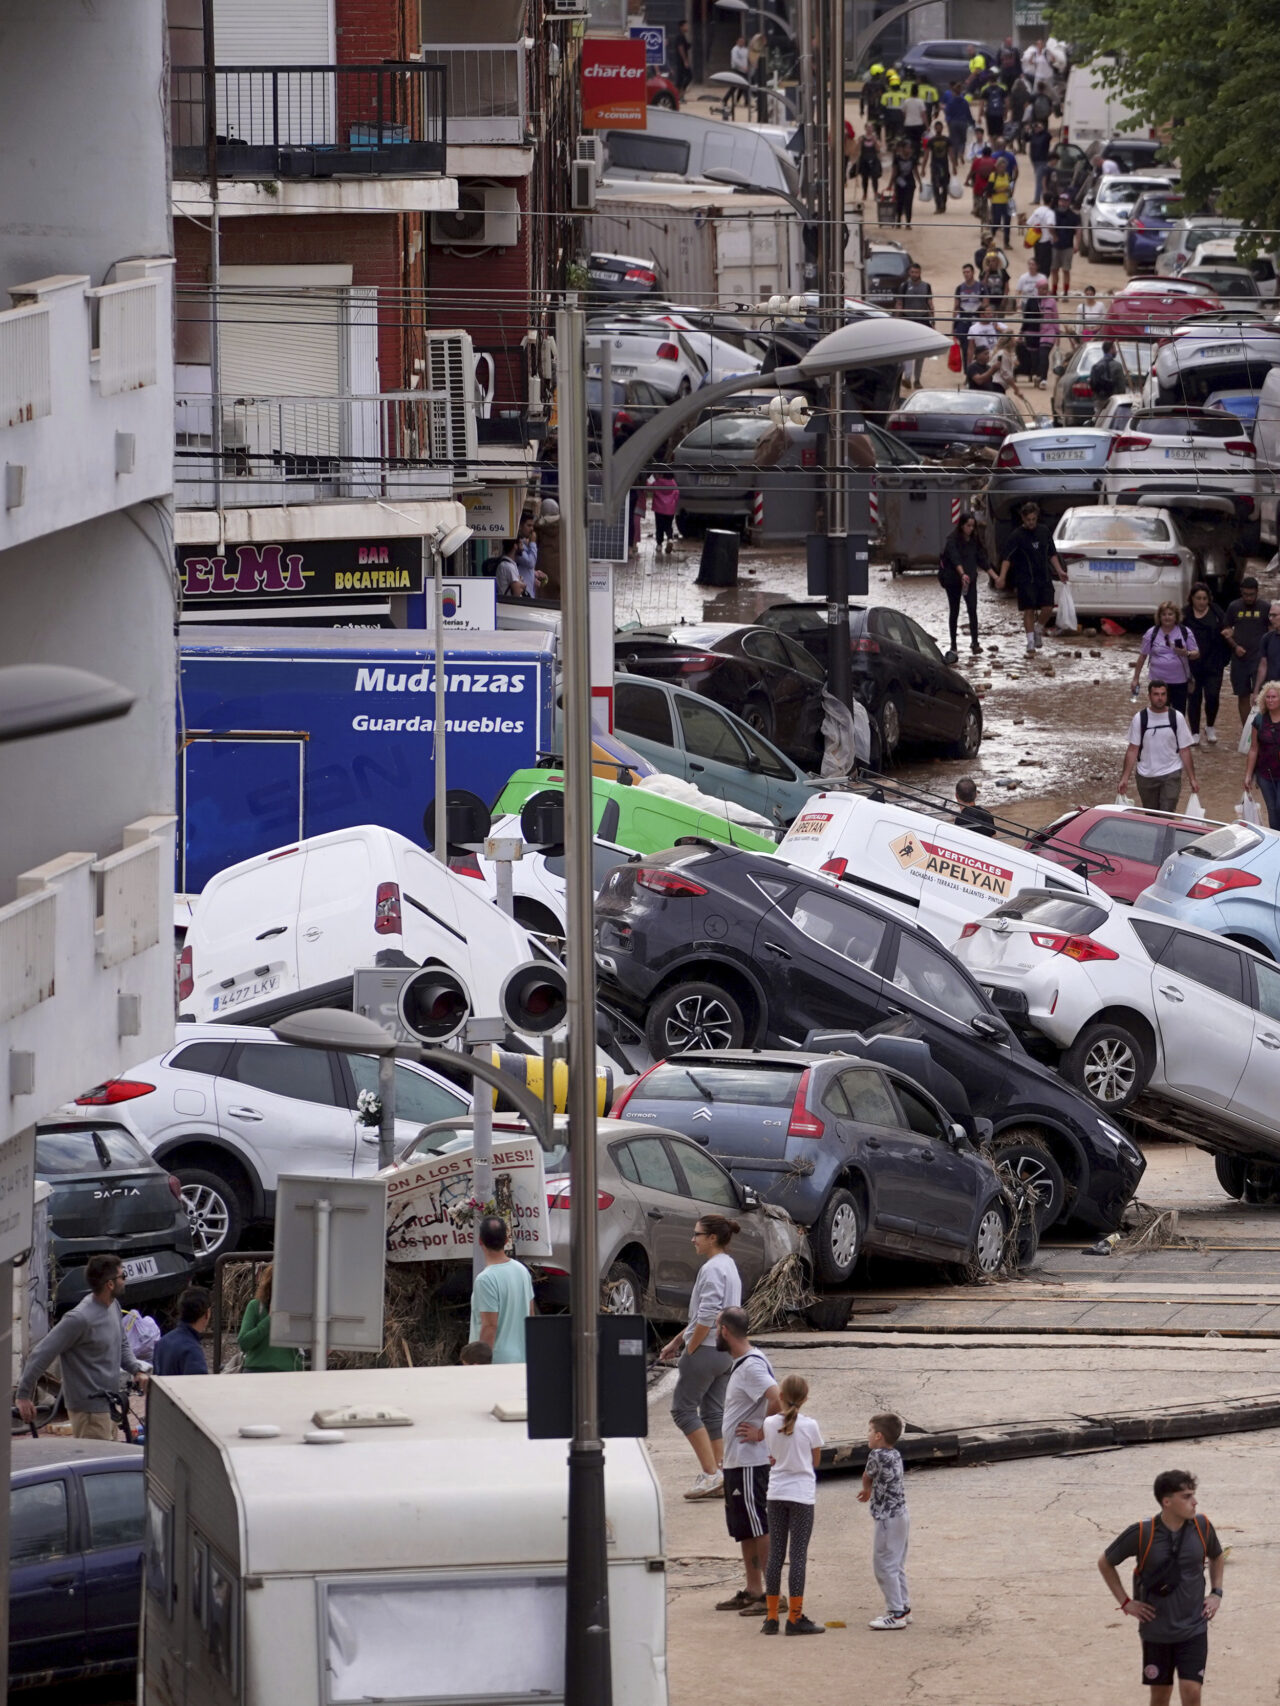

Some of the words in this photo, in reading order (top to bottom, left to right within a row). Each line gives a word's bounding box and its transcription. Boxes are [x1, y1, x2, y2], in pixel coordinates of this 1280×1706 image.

[583, 64, 645, 78] charter
[604, 112, 642, 120] consum
[489, 524, 505, 532] 694
[358, 546, 390, 565] BAR
[334, 567, 411, 590] BOCATERÍA
[465, 620, 470, 628] y
[354, 668, 526, 693] Mudanzas
[937, 847, 1002, 877] VERTICALES
[926, 857, 1006, 894] APELYAN
[221, 987, 250, 1005] 4477
[253, 978, 277, 994] LKV
[762, 1119, 782, 1127] C4
[415, 1173, 426, 1184] A
[429, 1161, 461, 1179] LOS
[93, 1188, 140, 1199] DACIA
[422, 1232, 449, 1251] por
[453, 1230, 474, 1245] las
[137, 1259, 155, 1275] MVT
